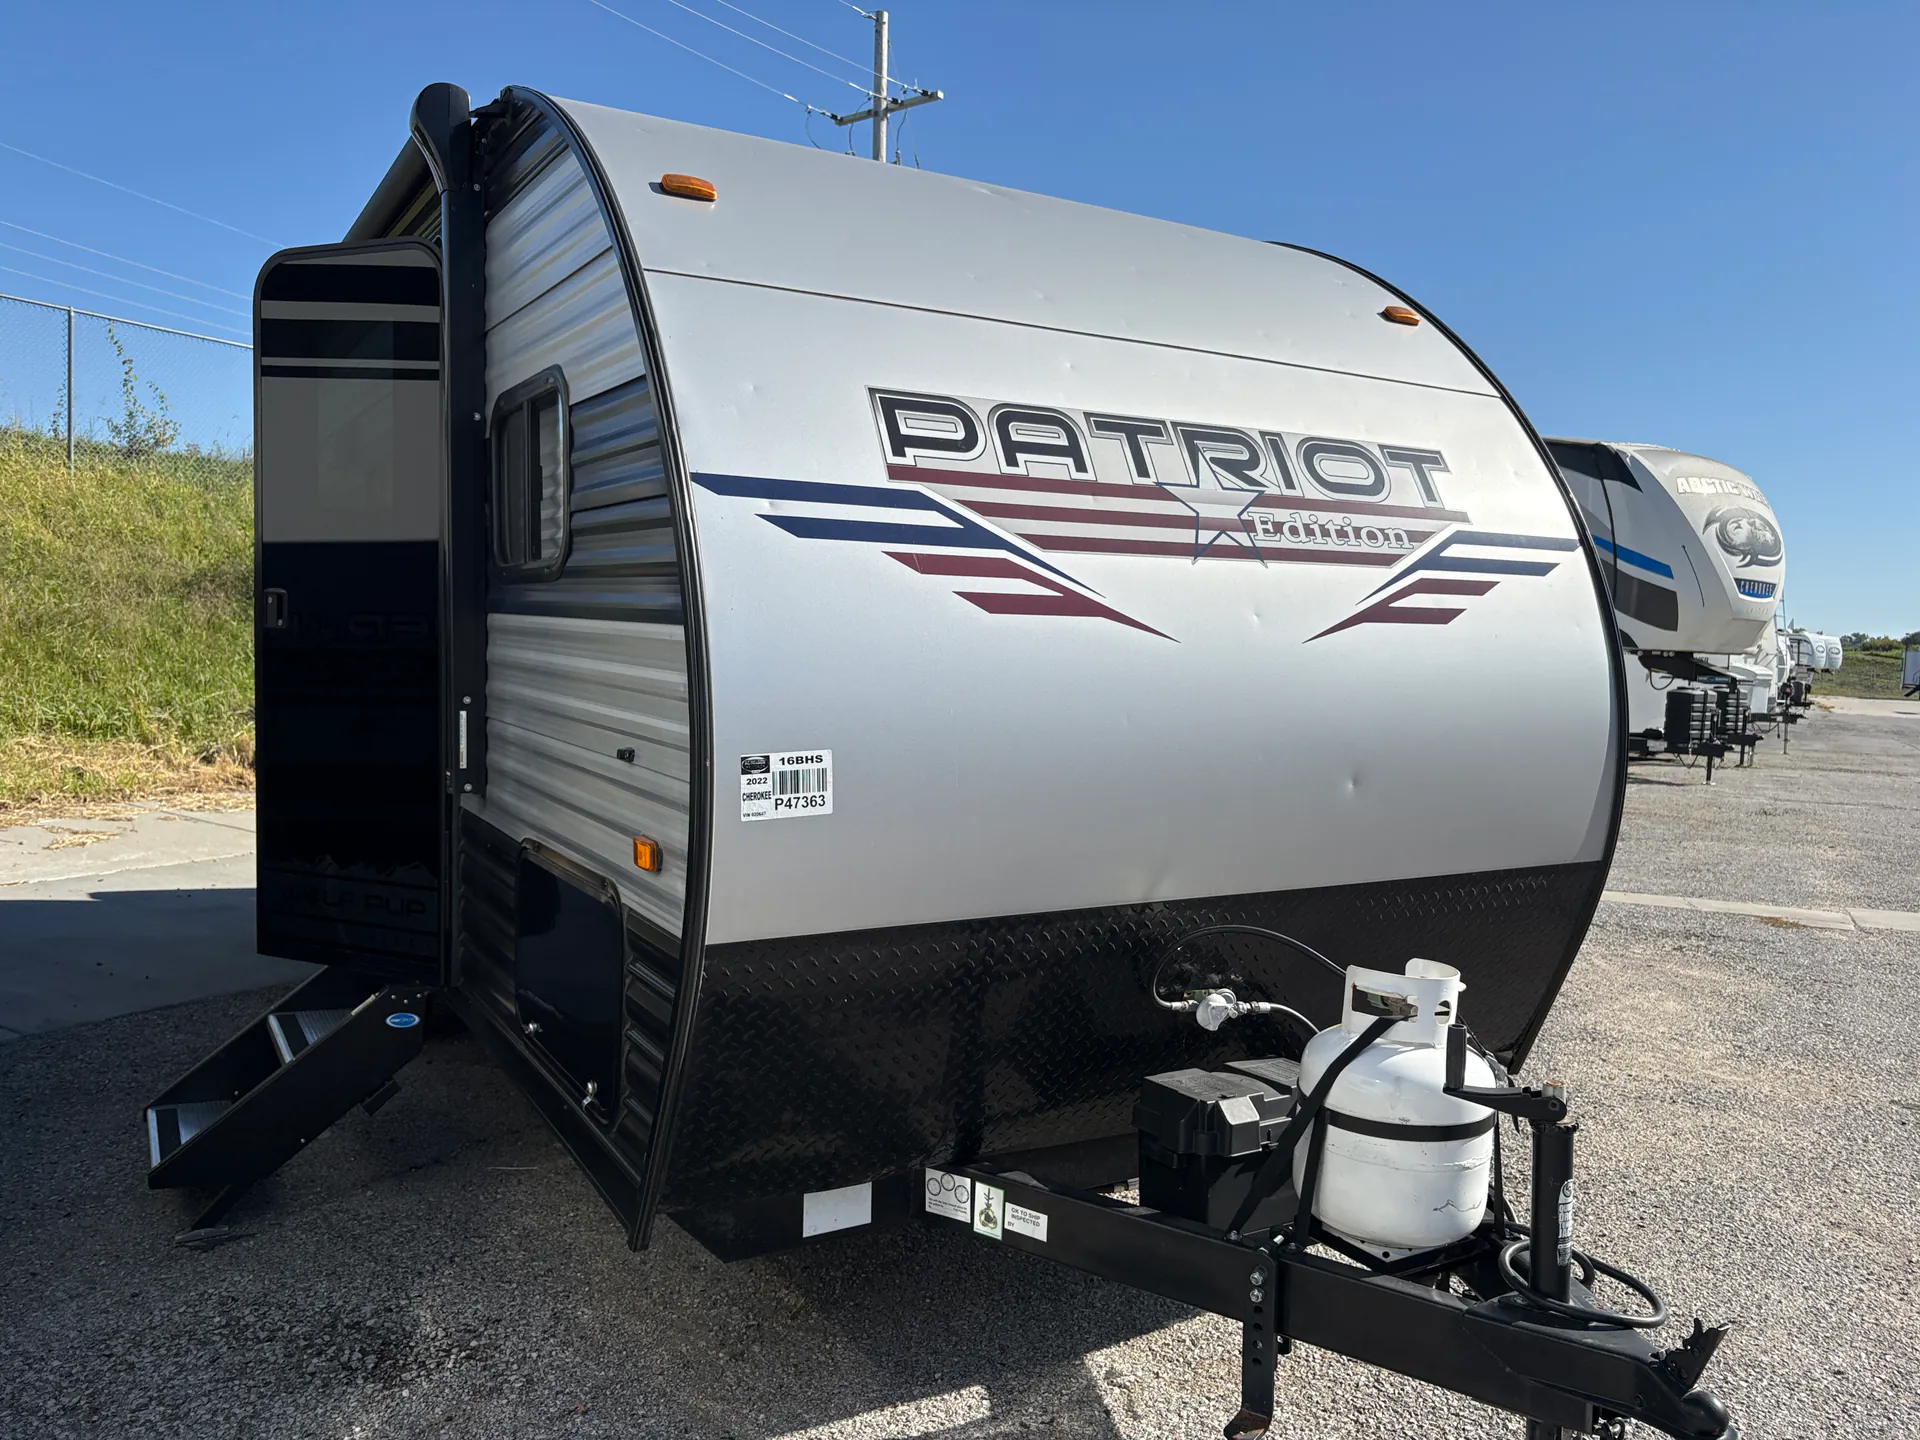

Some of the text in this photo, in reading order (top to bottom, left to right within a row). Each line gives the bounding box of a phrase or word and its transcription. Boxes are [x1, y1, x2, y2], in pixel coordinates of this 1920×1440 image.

[869, 388, 1450, 507] PATRIOT
[1676, 476, 1741, 496] ARCTIC
[1247, 512, 1415, 551] Edition
[1740, 580, 1772, 596] CHEROKEE
[779, 754, 823, 766] 16BHS
[746, 777, 768, 785] 2022
[742, 790, 772, 802] CHEROKEE
[774, 794, 826, 811] P47363
[1011, 1213, 1041, 1227] INSPECTED
